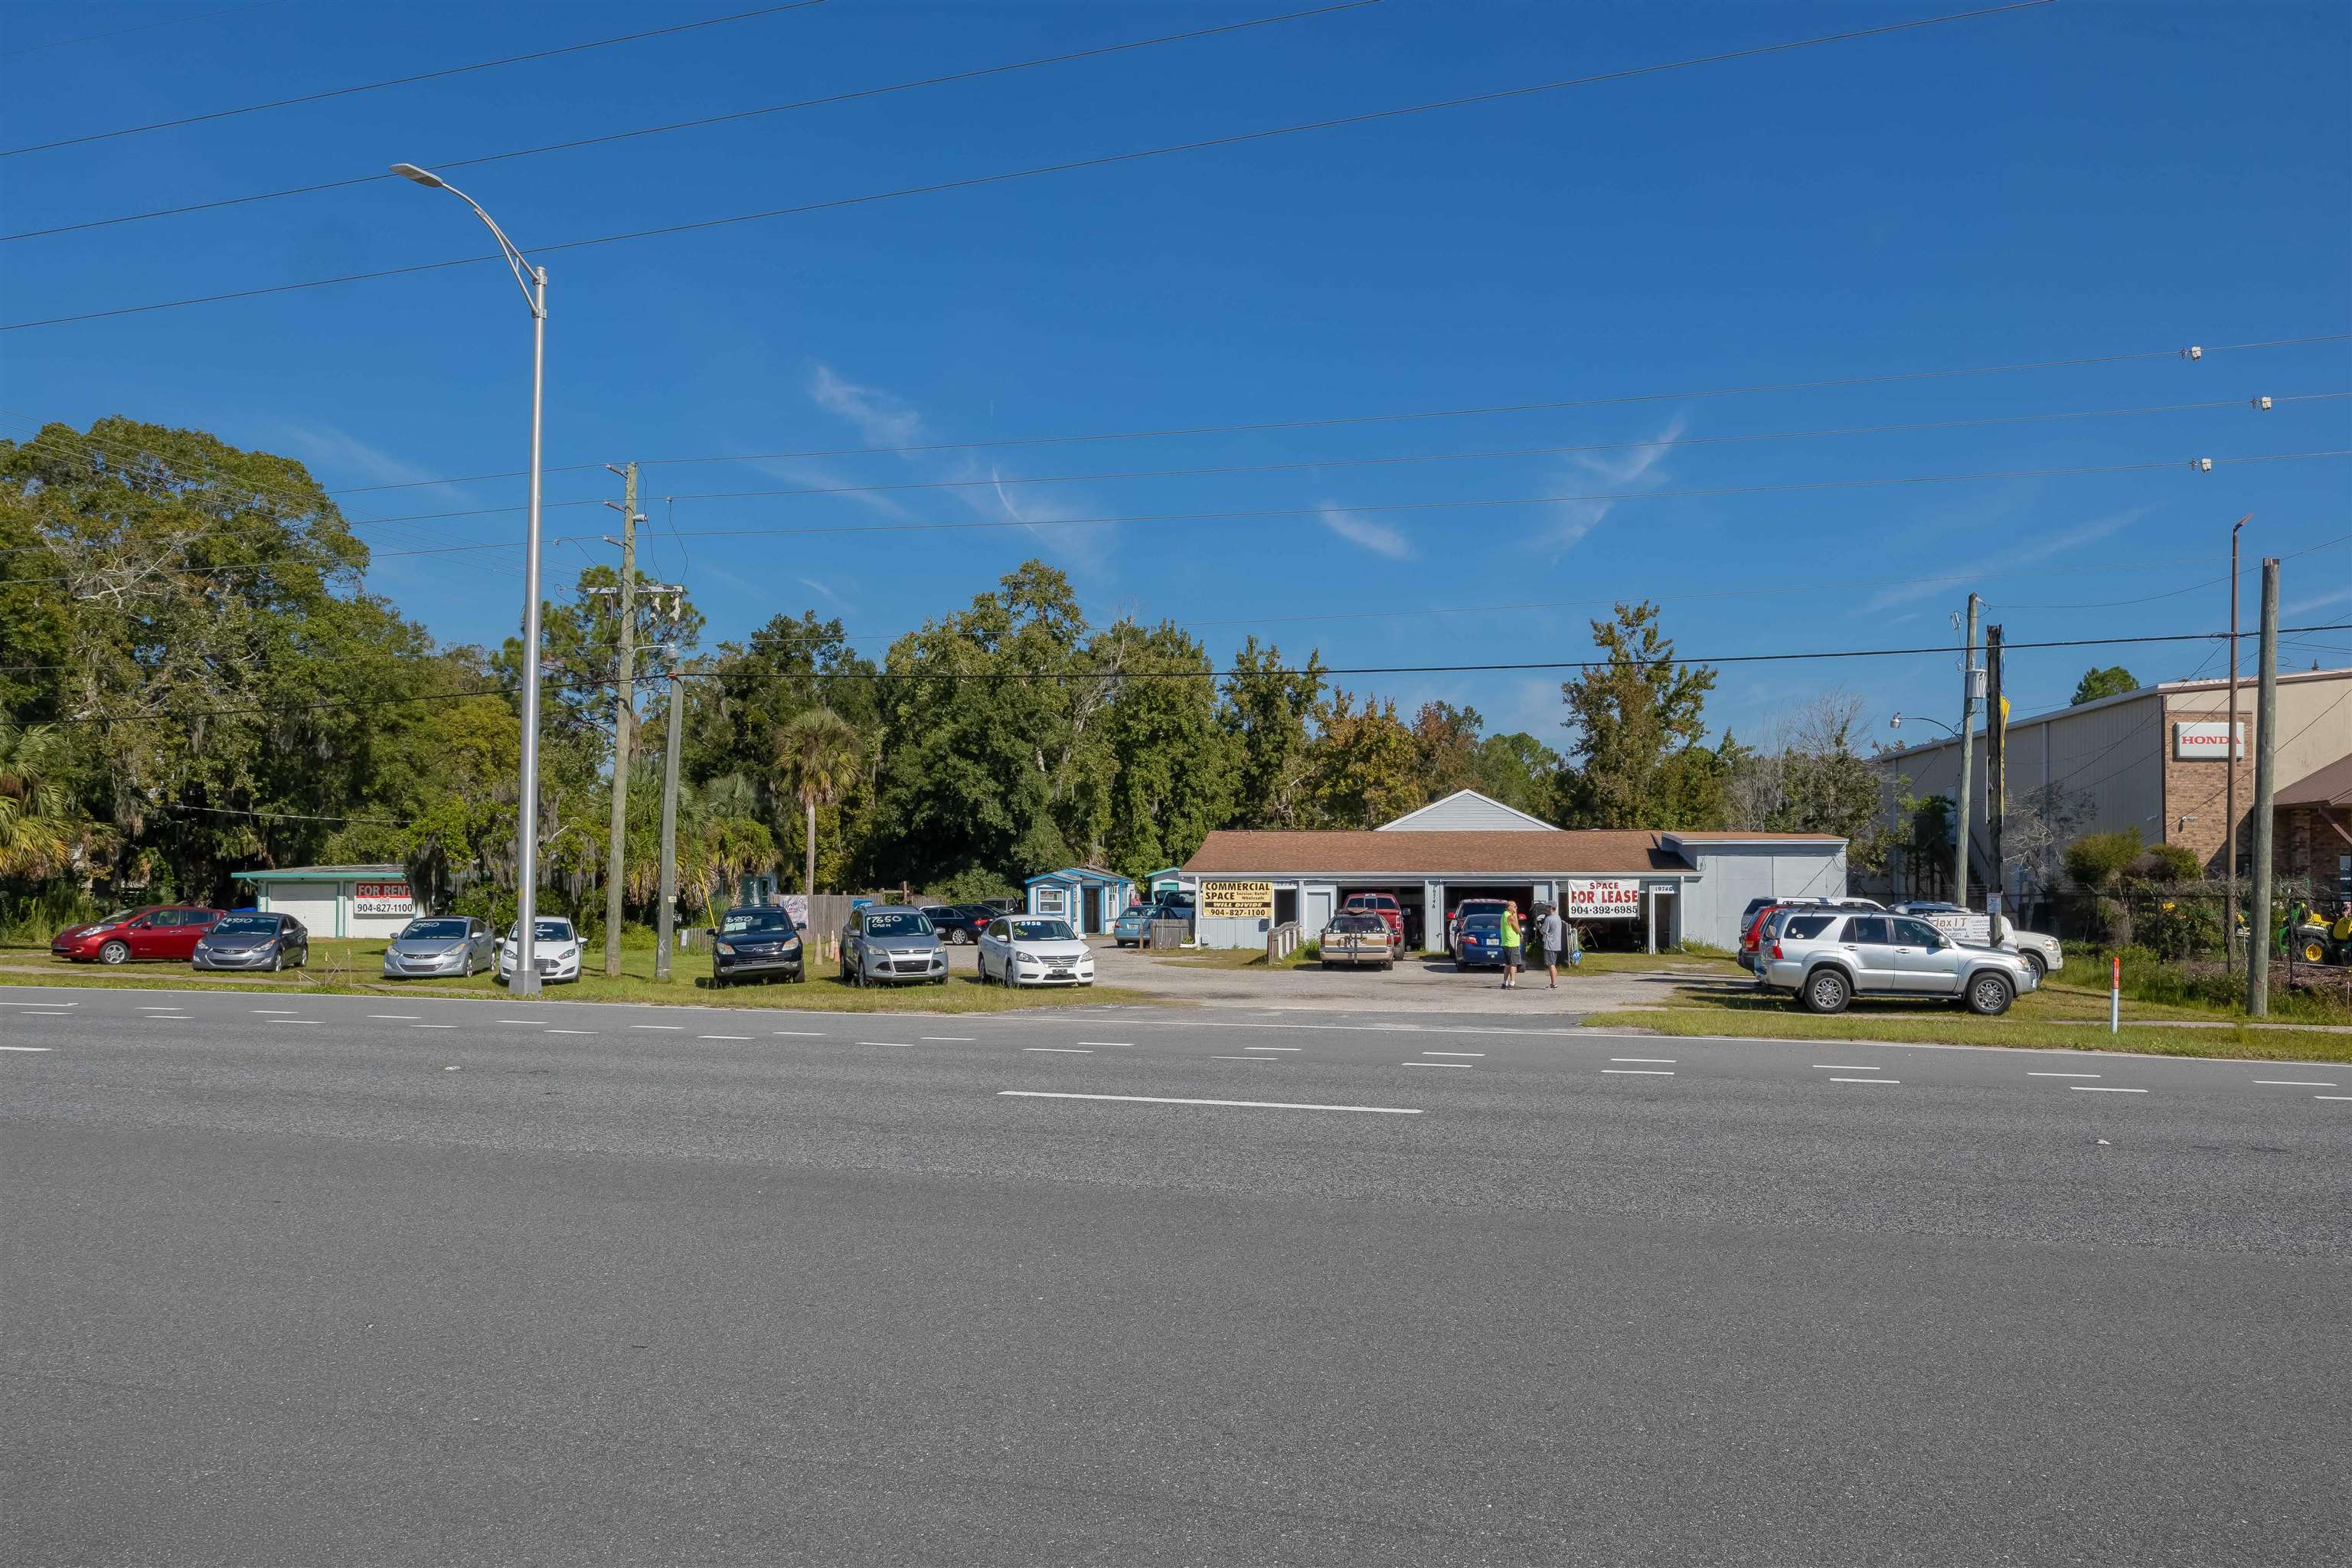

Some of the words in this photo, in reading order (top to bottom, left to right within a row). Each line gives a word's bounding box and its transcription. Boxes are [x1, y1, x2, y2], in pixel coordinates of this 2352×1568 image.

[358, 885, 380, 895] FOR
[1205, 882, 1270, 890] COMMERCIAL
[1571, 890, 1595, 903] FOR
[1602, 890, 1638, 903] LEASE
[357, 903, 413, 912] 904-827-1100
